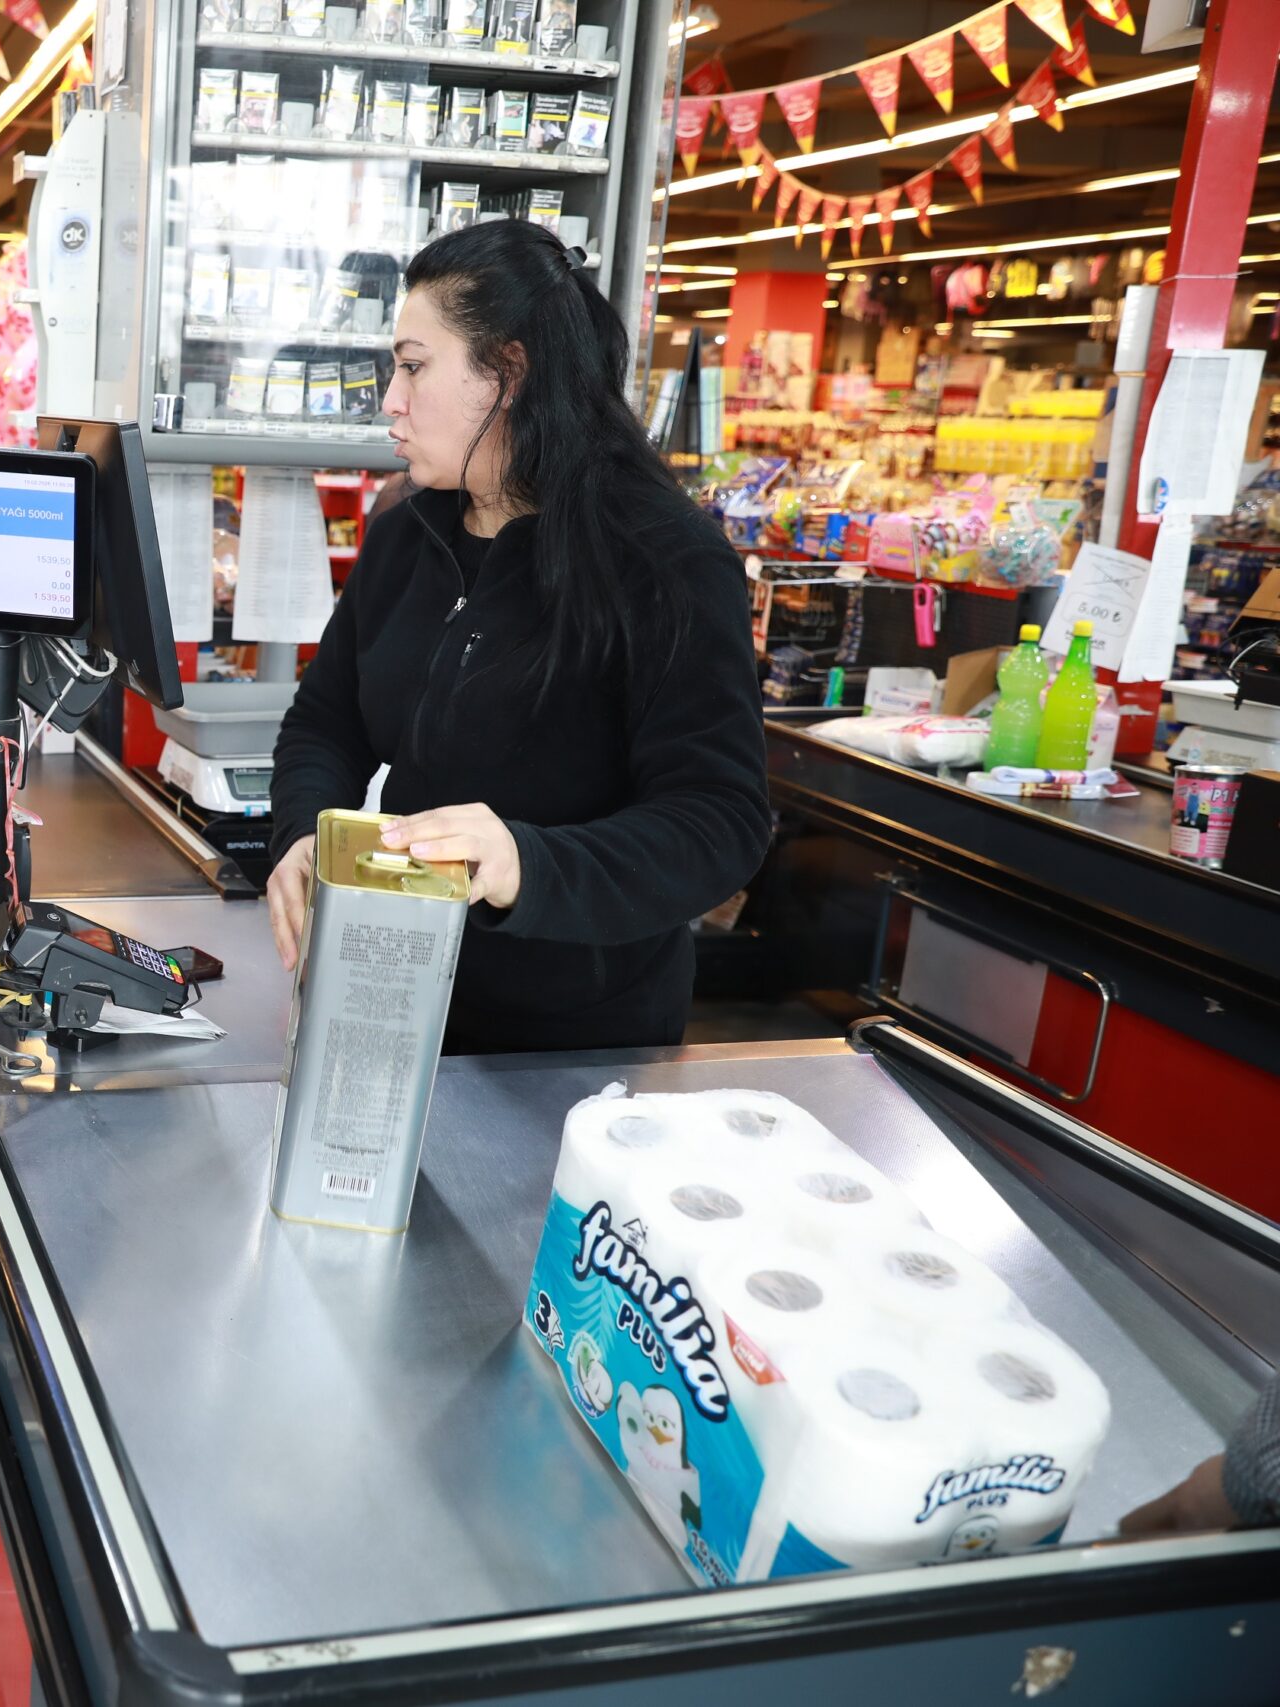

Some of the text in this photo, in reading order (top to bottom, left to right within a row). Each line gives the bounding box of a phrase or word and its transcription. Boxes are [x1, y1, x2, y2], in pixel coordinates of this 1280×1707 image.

[28, 508, 64, 521] 5000ml
[64, 569, 71, 578] 0
[573, 1200, 730, 1423] familia
[616, 1302, 666, 1374] PLUS
[914, 1454, 1067, 1524] familia
[967, 1492, 1010, 1511] PLUS
